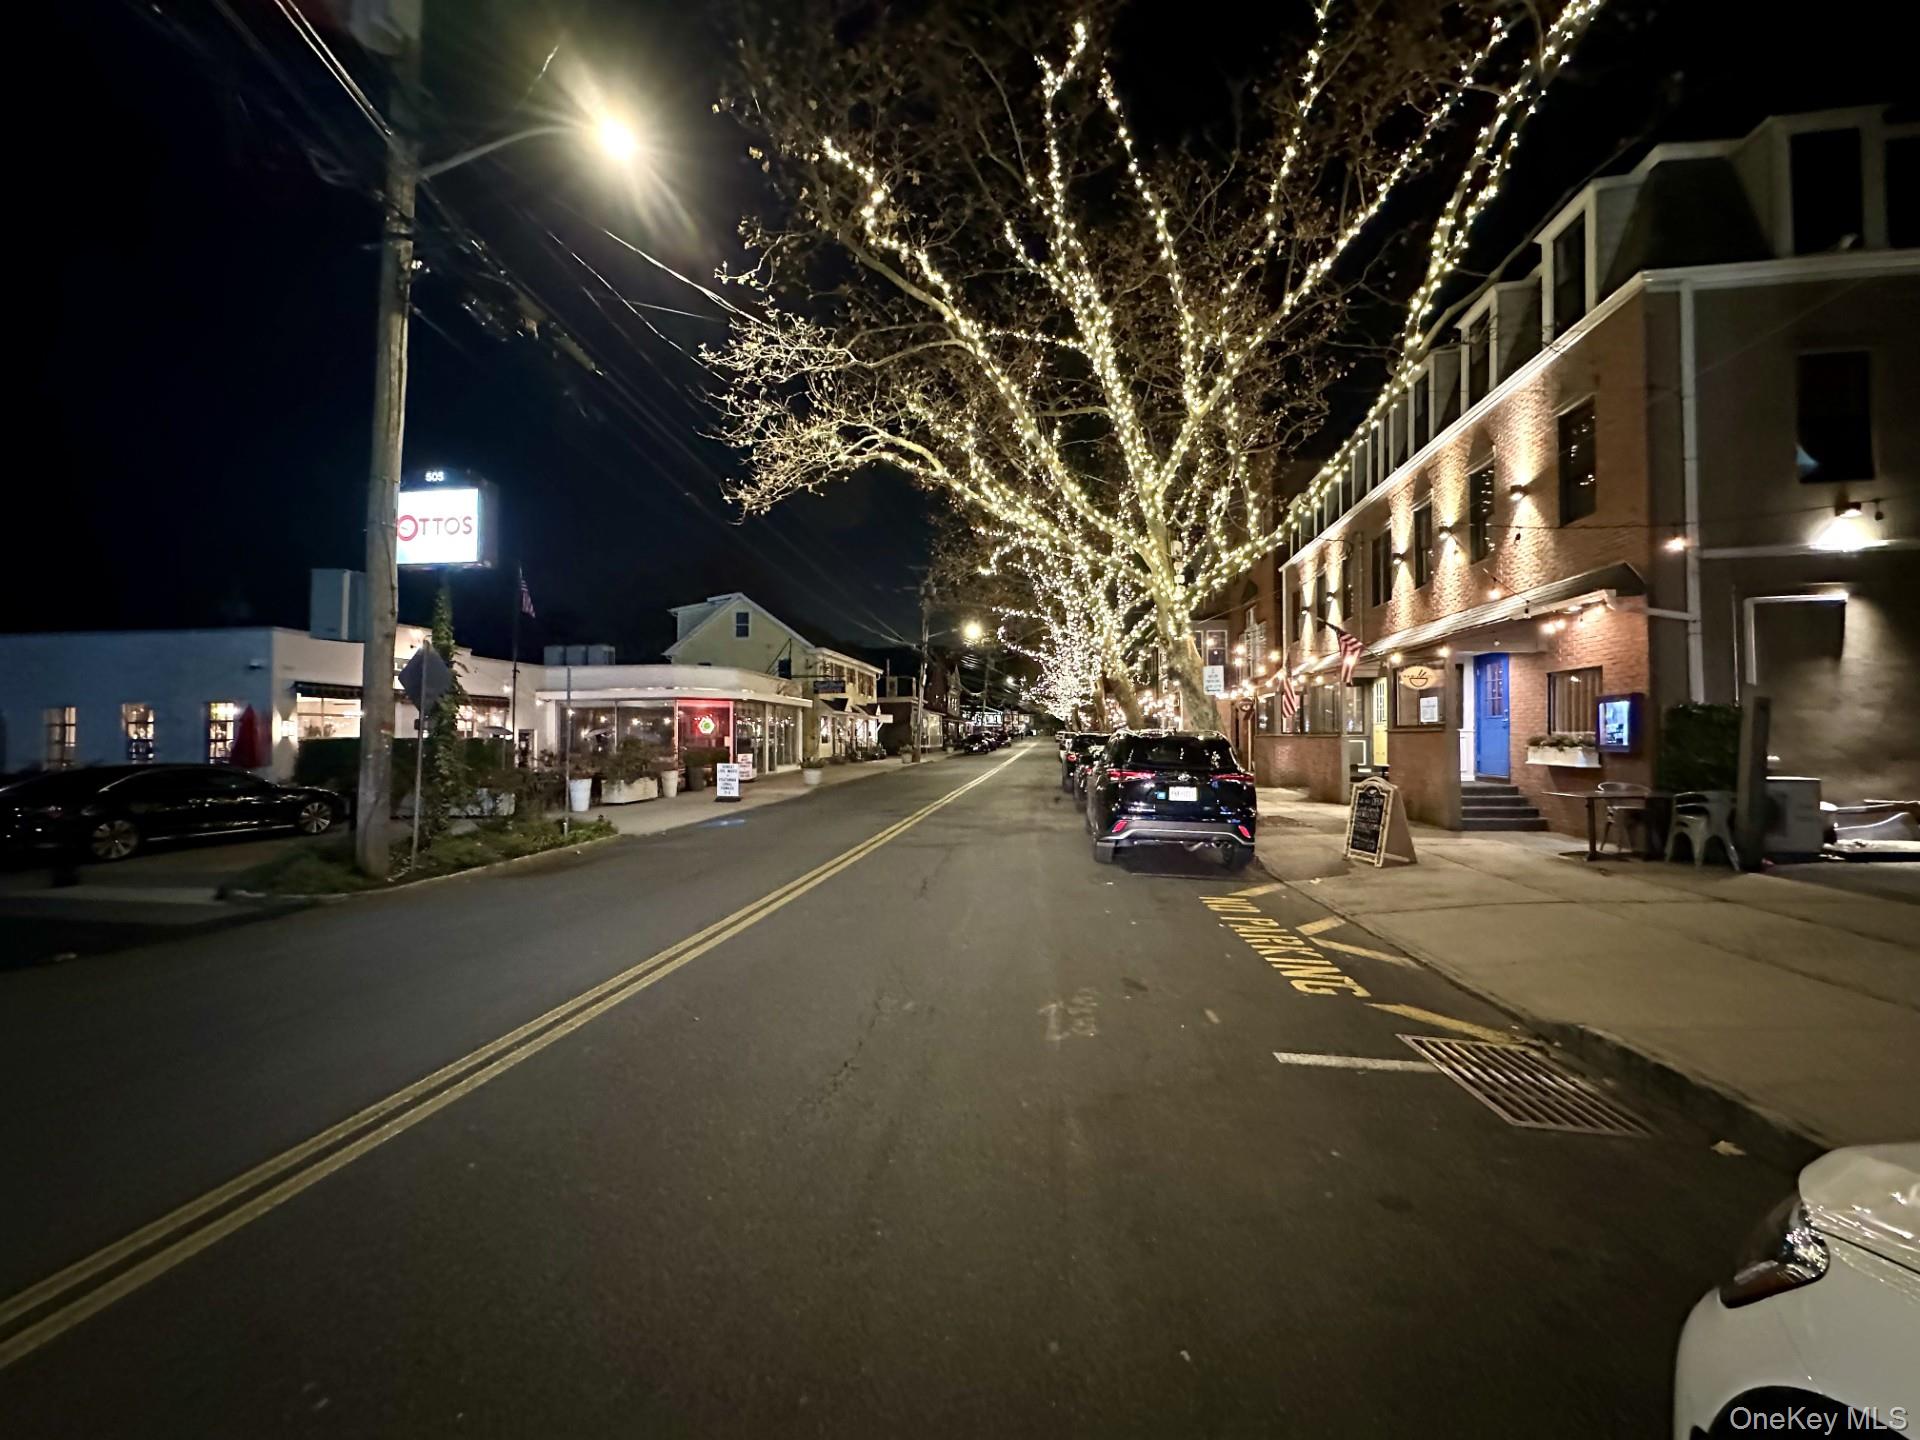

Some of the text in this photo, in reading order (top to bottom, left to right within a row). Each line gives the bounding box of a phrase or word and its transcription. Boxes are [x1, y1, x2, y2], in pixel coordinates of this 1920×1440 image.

[425, 471, 444, 482] 505
[396, 515, 473, 541] OTTOS
[1199, 896, 1371, 997] NO PARKING
